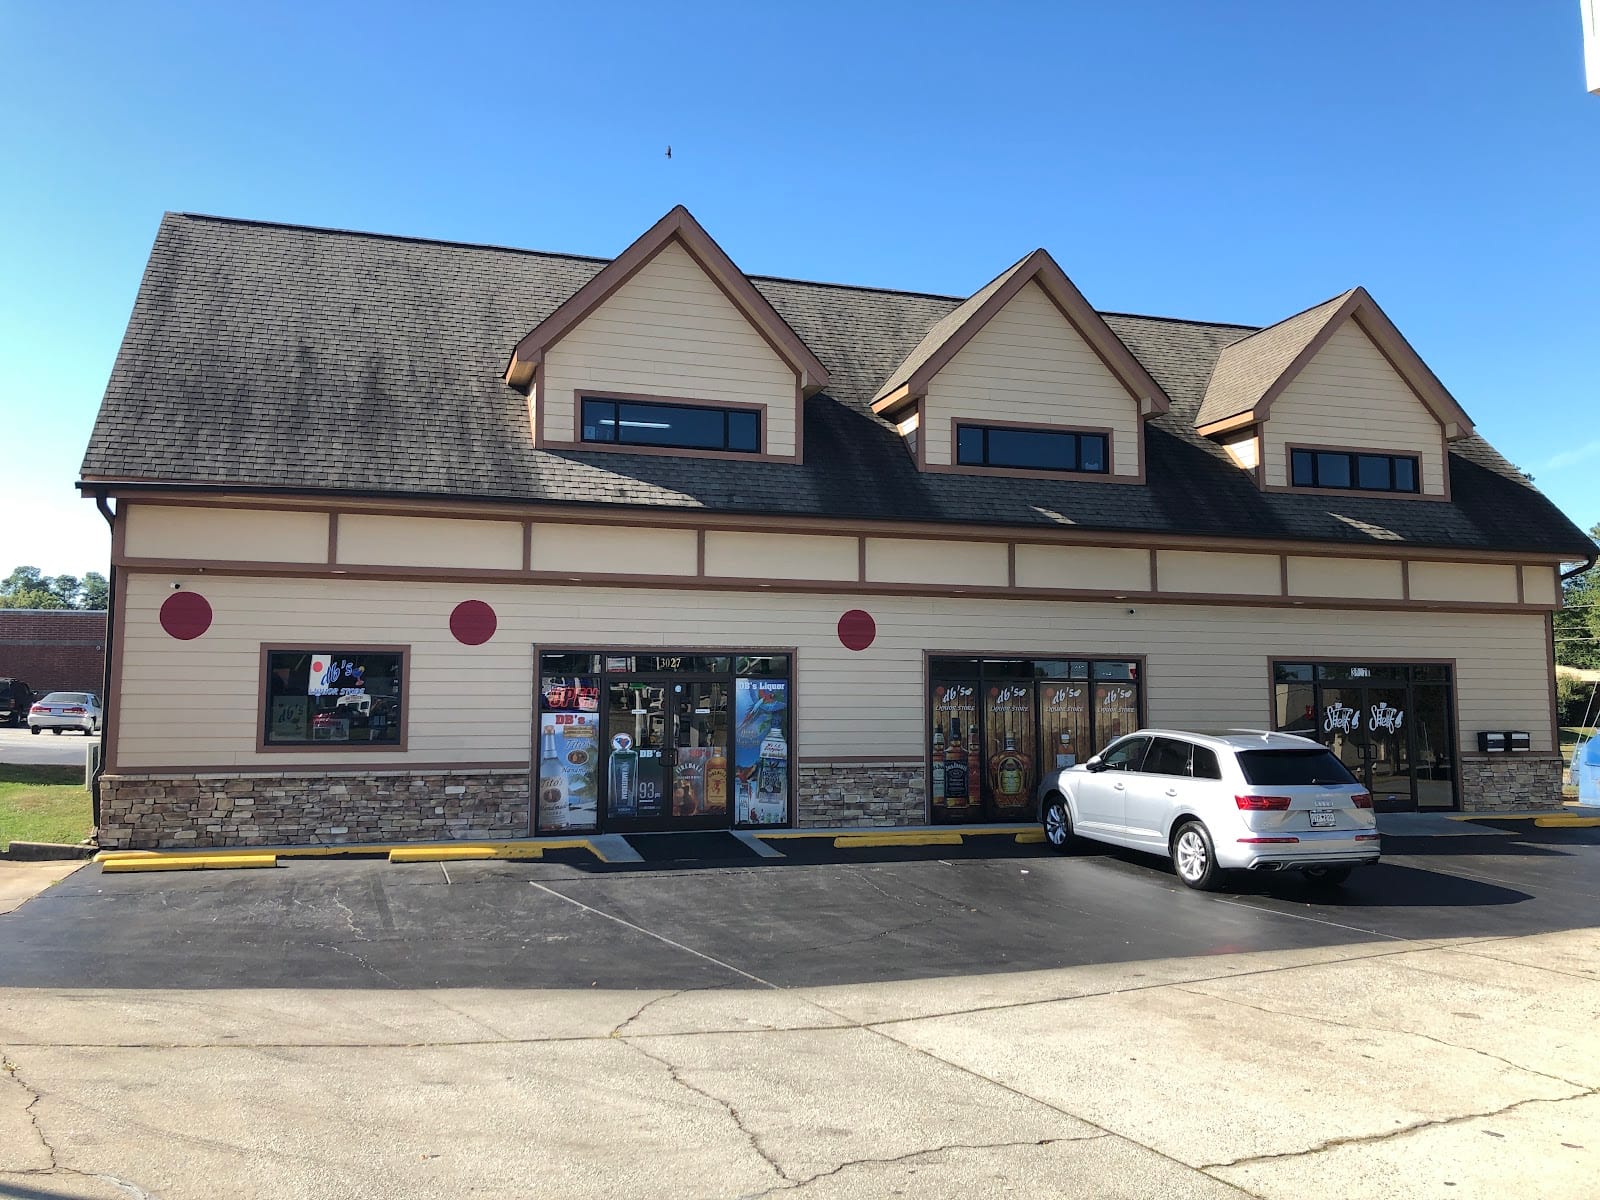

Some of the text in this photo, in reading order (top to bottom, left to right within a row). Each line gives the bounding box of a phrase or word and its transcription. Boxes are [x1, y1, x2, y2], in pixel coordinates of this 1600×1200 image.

[759, 681, 785, 692] Liquor
[548, 687, 600, 709] OPEN
[640, 782, 655, 799] 93
